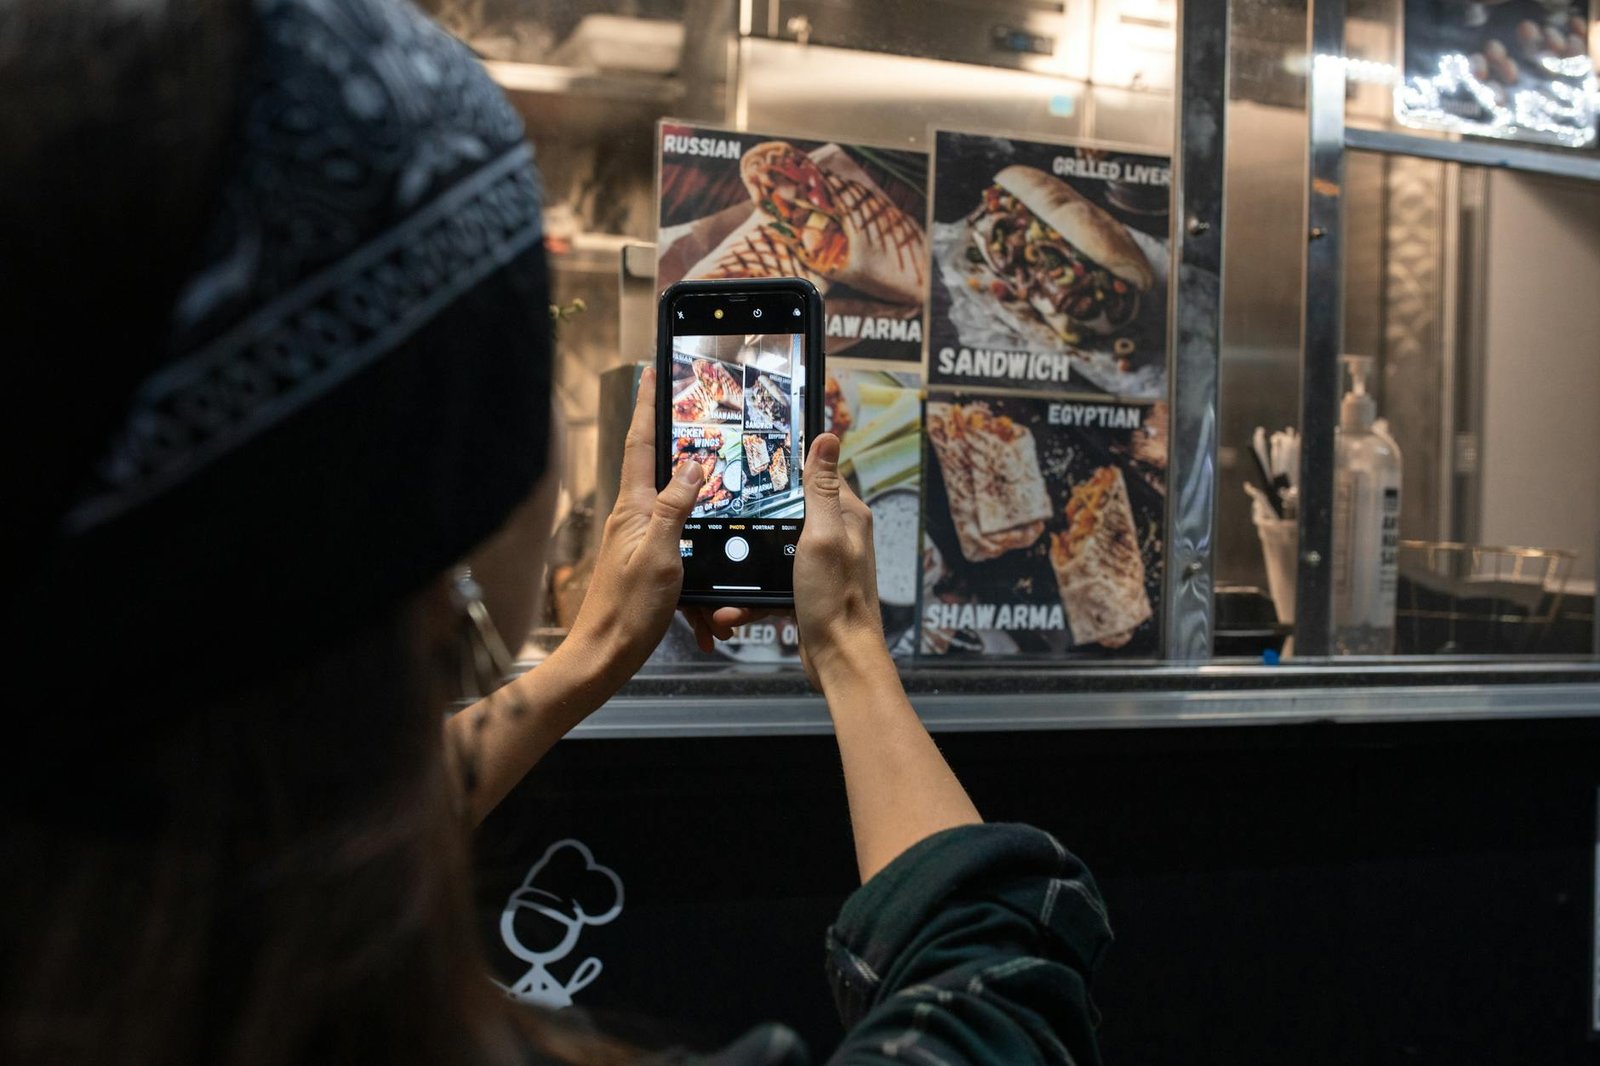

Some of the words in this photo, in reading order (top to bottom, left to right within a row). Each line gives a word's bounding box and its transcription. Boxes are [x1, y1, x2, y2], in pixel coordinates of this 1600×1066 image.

[663, 134, 741, 160] RUSSIAN
[1053, 155, 1121, 180] GRILLED
[1123, 162, 1171, 187] LIVER
[825, 313, 922, 343] AWARMA
[938, 347, 1070, 383] SANDWICH
[745, 420, 774, 430] SANDWICH
[1047, 403, 1141, 430] EGYPTIAN
[694, 437, 720, 448] WINGS
[926, 602, 1066, 632] SHAWARMA
